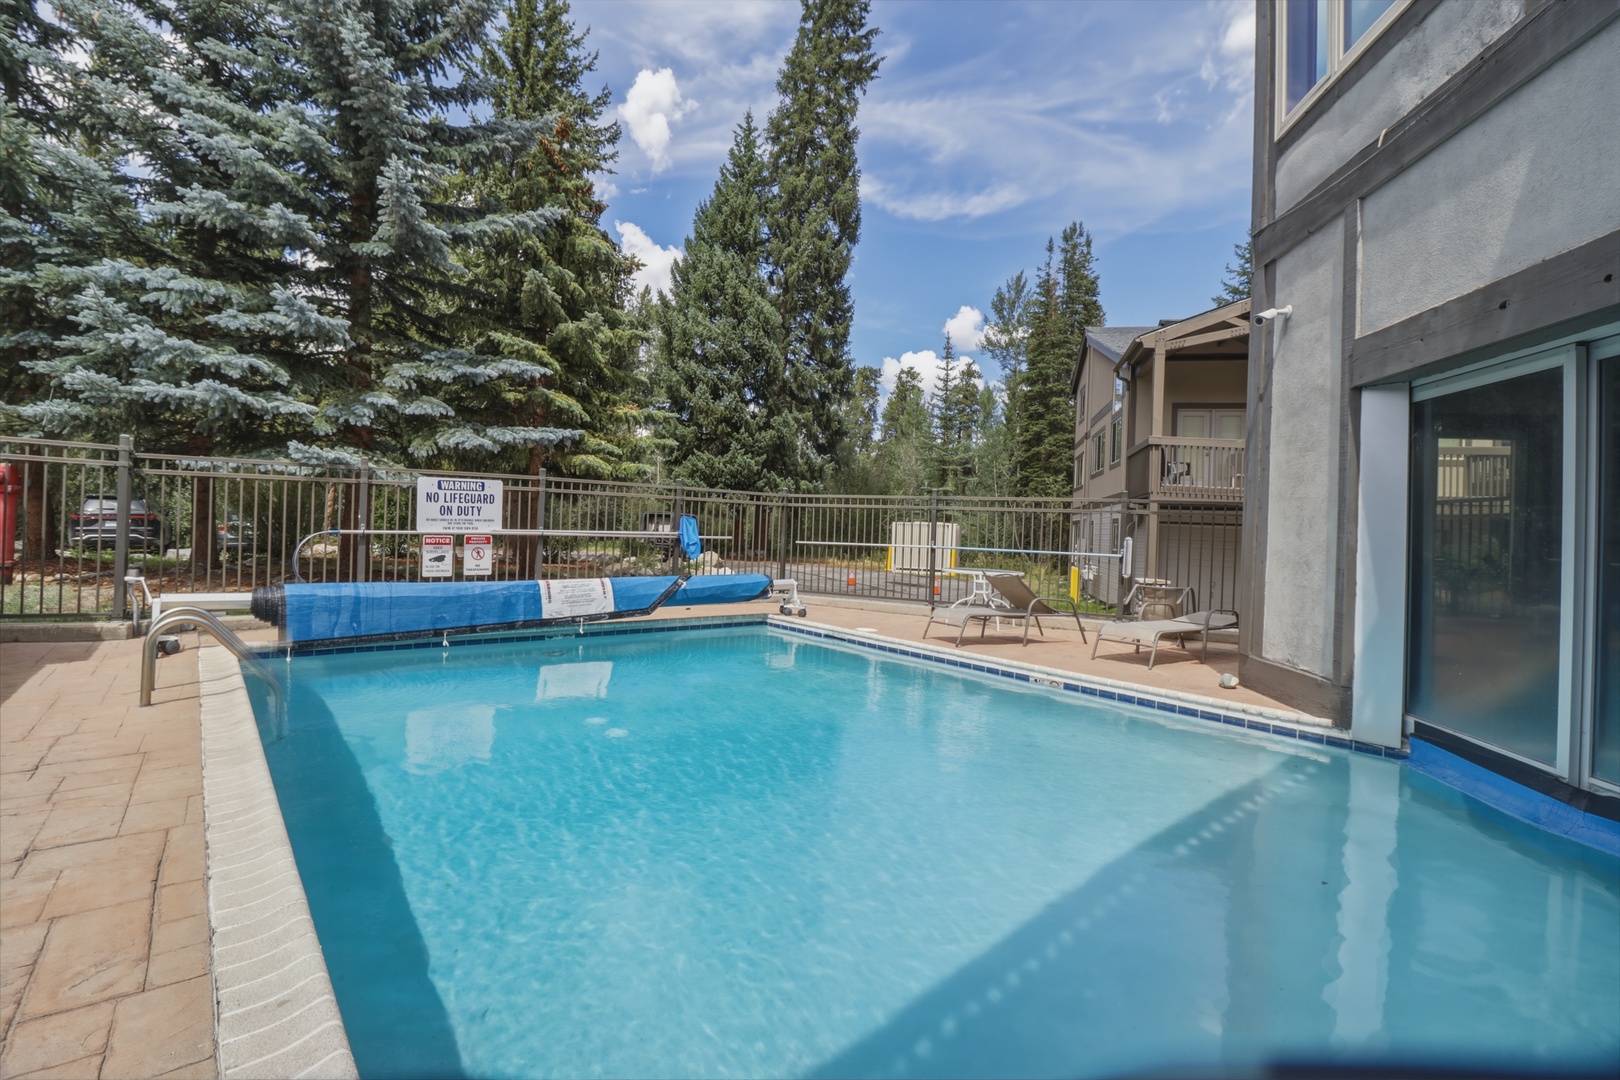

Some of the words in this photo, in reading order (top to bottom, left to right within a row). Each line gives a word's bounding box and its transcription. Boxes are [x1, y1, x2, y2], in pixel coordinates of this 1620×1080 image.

[440, 480, 483, 491] WARNING
[426, 491, 440, 503] NO
[444, 492, 495, 504] LIFEGUARD
[439, 505, 453, 516] ON
[457, 505, 482, 517] DUTY
